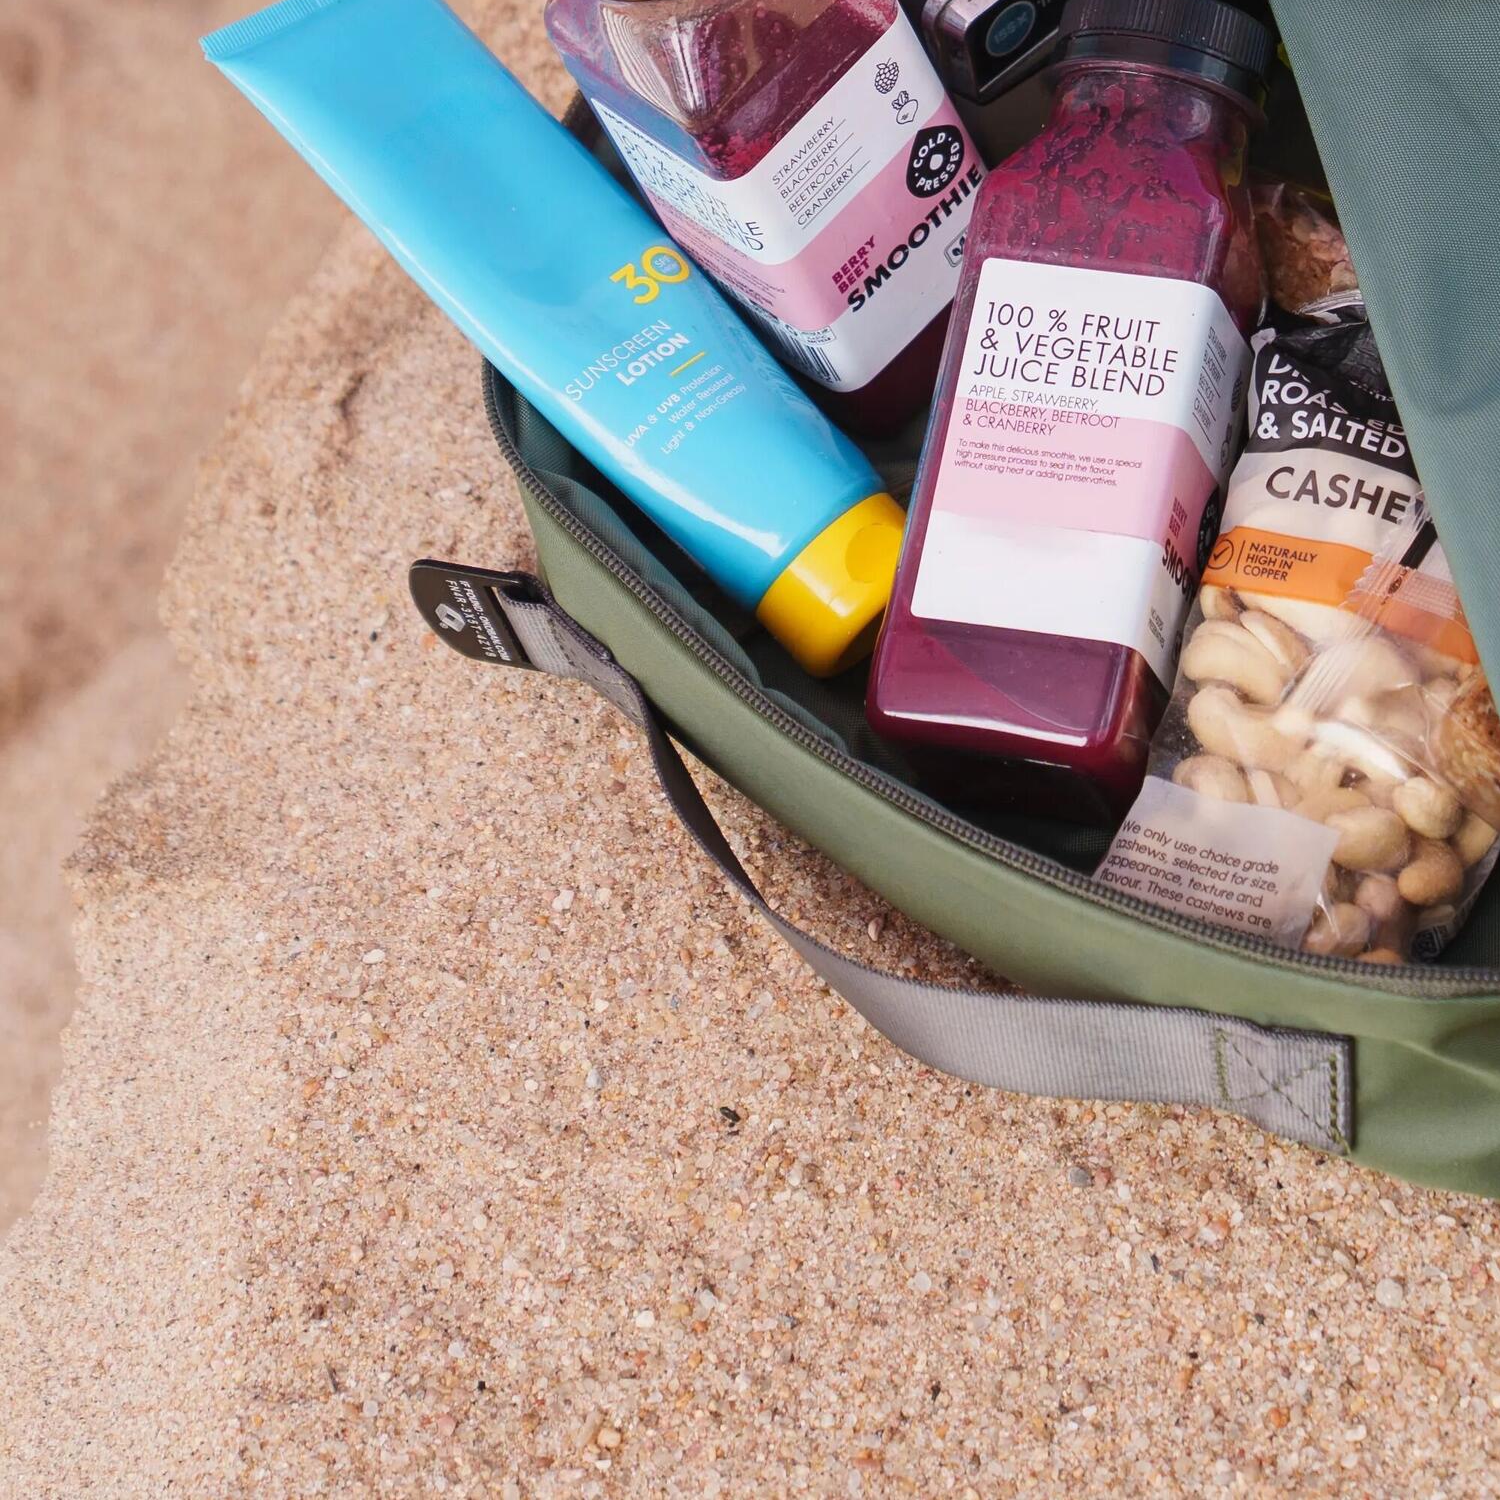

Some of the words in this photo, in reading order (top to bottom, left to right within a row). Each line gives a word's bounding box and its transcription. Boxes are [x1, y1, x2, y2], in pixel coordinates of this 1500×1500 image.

[772, 117, 835, 185] STRAWBERRY
[781, 135, 840, 199] BLACKBERRY
[913, 132, 946, 168] COLD
[916, 142, 960, 192] PRESSED
[789, 158, 839, 213] BEETROOT
[798, 165, 855, 226] CRANBERRY
[832, 235, 876, 284] BERRY
[847, 164, 984, 312] SMOOTHIE
[609, 245, 691, 305] 30
[838, 258, 870, 295] BEET
[988, 302, 1034, 328] 100
[1048, 309, 1068, 332] %
[1081, 314, 1161, 343] FRUIT
[565, 320, 672, 402] SUNSCREEN
[616, 332, 691, 386] LOTION
[980, 328, 999, 351] &
[1015, 332, 1179, 373] VEGETABLE
[669, 399, 697, 424] Water
[697, 373, 735, 401] Resistant
[968, 384, 1007, 402] APPLE,
[1011, 389, 1099, 412] STRAWBERRY,
[973, 354, 1060, 385] JUICE
[1071, 366, 1165, 397] BLEND
[624, 424, 648, 448] UVA
[647, 412, 659, 424] &
[656, 393, 681, 414] UVB
[680, 364, 724, 396] Protection
[661, 430, 686, 455] Light
[685, 421, 696, 431] &
[695, 384, 747, 422] Non-Greasy
[962, 414, 972, 426] &
[977, 416, 1056, 436] CRANBERRY
[966, 399, 1048, 422] BLACKBERRY,
[1051, 409, 1121, 429] BEETROOT
[959, 438, 968, 447] To
[969, 441, 990, 450] make
[991, 443, 1005, 452] this
[1006, 445, 1039, 457] delicious
[1078, 455, 1092, 463] we
[1115, 459, 1142, 469] special
[1257, 412, 1280, 440] &
[1292, 410, 1406, 458] SALTED
[954, 459, 983, 470] without
[984, 462, 1004, 474] using
[1006, 465, 1024, 475] heat
[1025, 468, 1035, 476] or
[1036, 469, 1064, 482] adding
[956, 449, 973, 459] high
[974, 452, 1007, 463] pressure
[1008, 456, 1038, 468] process
[1040, 459, 1048, 468] to
[1049, 461, 1065, 470] seal
[1066, 462, 1074, 471] in
[1075, 463, 1087, 473] the
[1089, 465, 1115, 476] flavour
[1244, 565, 1288, 582] COPPER
[1246, 554, 1277, 569] HIGH
[1279, 559, 1294, 570] IN
[1250, 543, 1318, 563] NATURALLY
[1122, 820, 1141, 834] We
[1144, 828, 1172, 847] only
[1174, 841, 1197, 855] use
[1200, 848, 1241, 867] choice
[1242, 860, 1279, 874] grade
[1100, 867, 1142, 891] flavour.
[1147, 880, 1183, 901] These
[1186, 895, 1244, 922] cashews
[1248, 914, 1272, 929] are
[1172, 857, 1227, 881] selected
[1231, 869, 1247, 885] for
[1250, 878, 1279, 894] size,
[1188, 878, 1234, 900] texture
[1236, 893, 1263, 908] and
